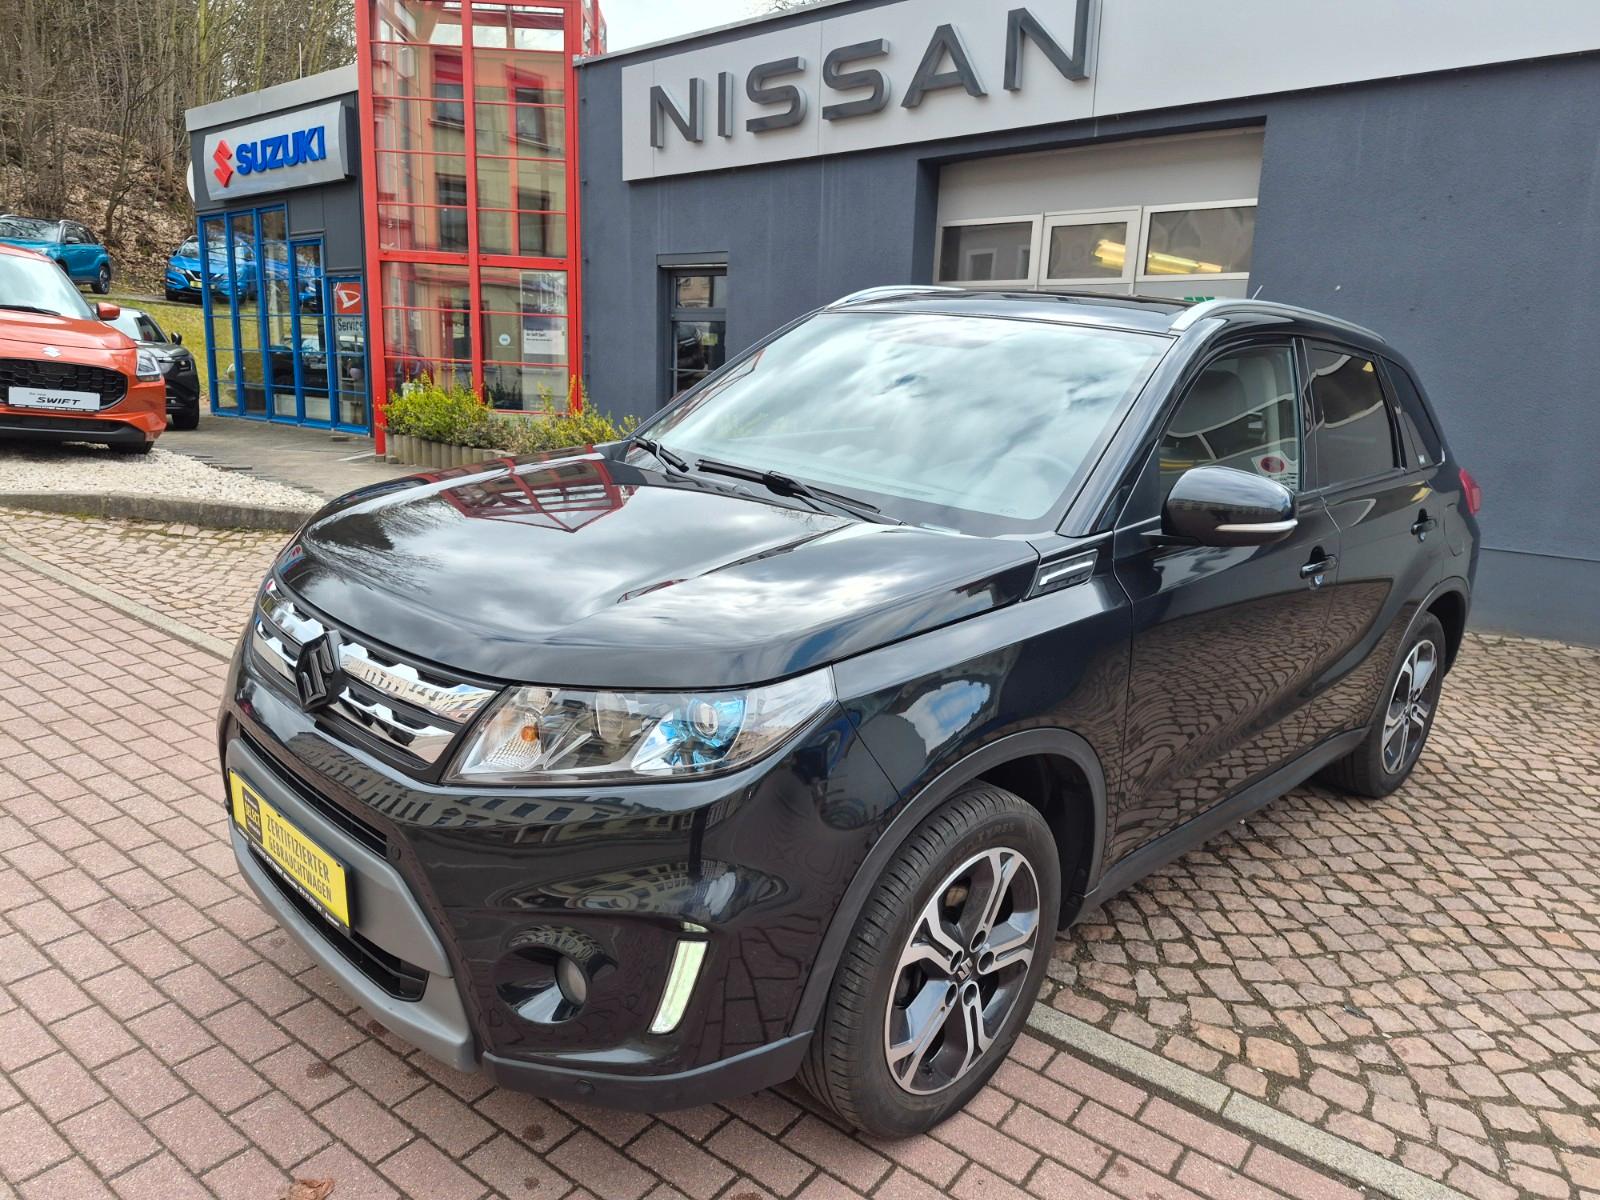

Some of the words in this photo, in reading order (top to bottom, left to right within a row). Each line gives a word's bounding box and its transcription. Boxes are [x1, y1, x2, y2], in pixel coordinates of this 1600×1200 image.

[650, 0, 1091, 149] NISSAN
[236, 126, 326, 176] SUZUKI
[337, 317, 363, 331] Service
[36, 396, 80, 406] SWIFT
[266, 814, 330, 883] ZERTIFIZIERTER
[268, 836, 332, 903] GEBRAUCHTWAGEN
